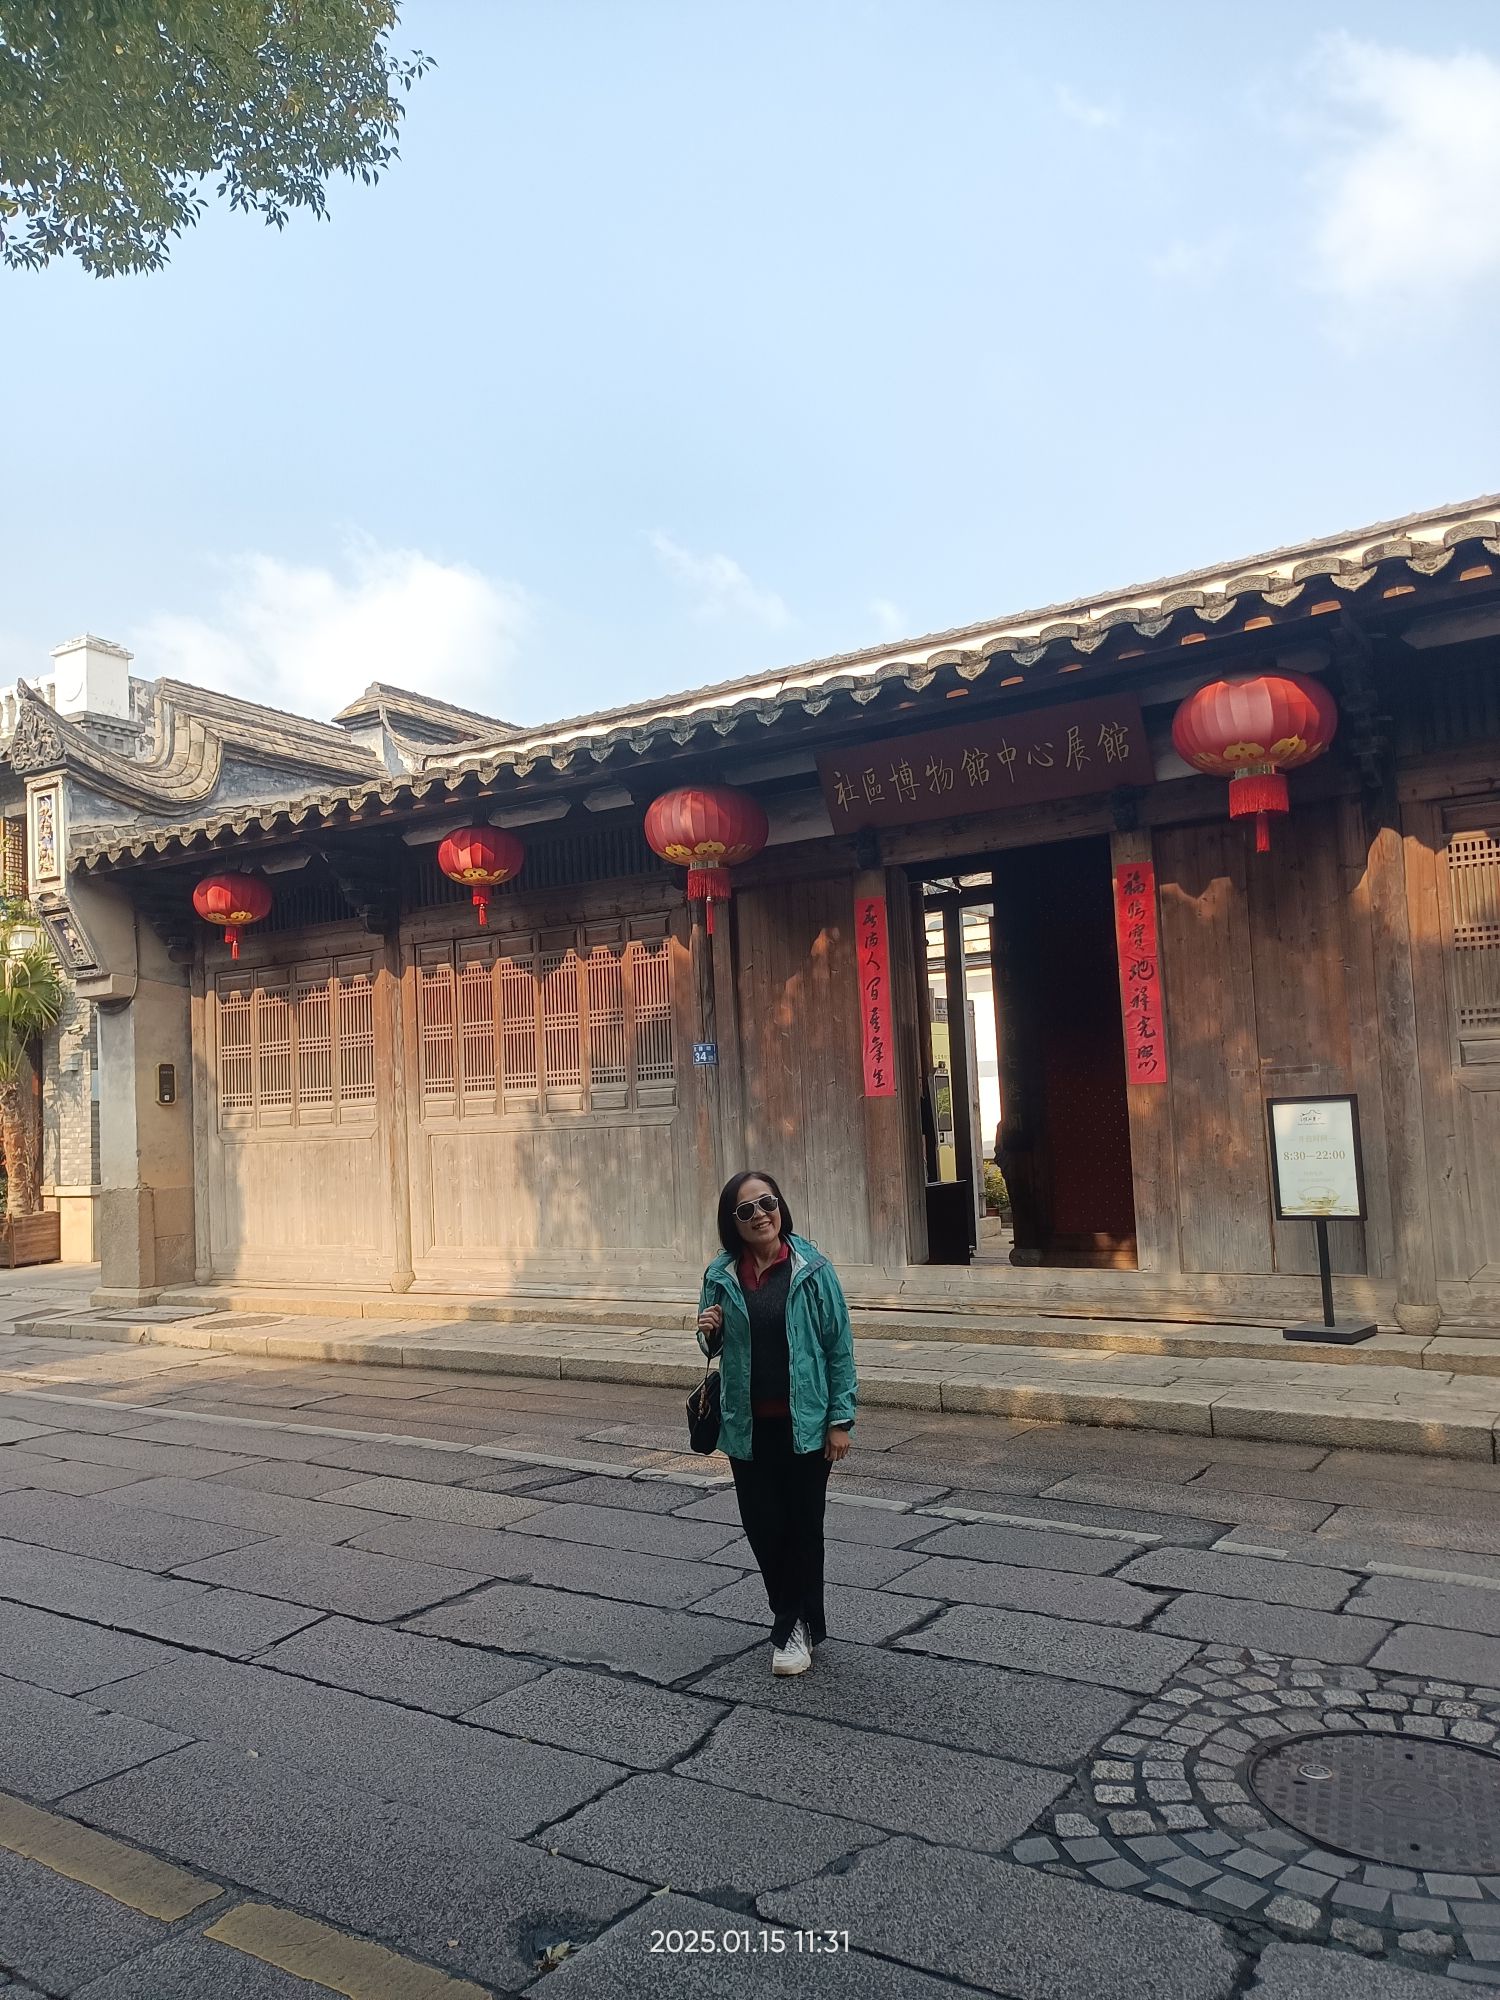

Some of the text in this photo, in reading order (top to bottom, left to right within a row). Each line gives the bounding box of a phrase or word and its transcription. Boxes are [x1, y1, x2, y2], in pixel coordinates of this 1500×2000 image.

[833, 721, 1130, 812] 社區博物館中心展館
